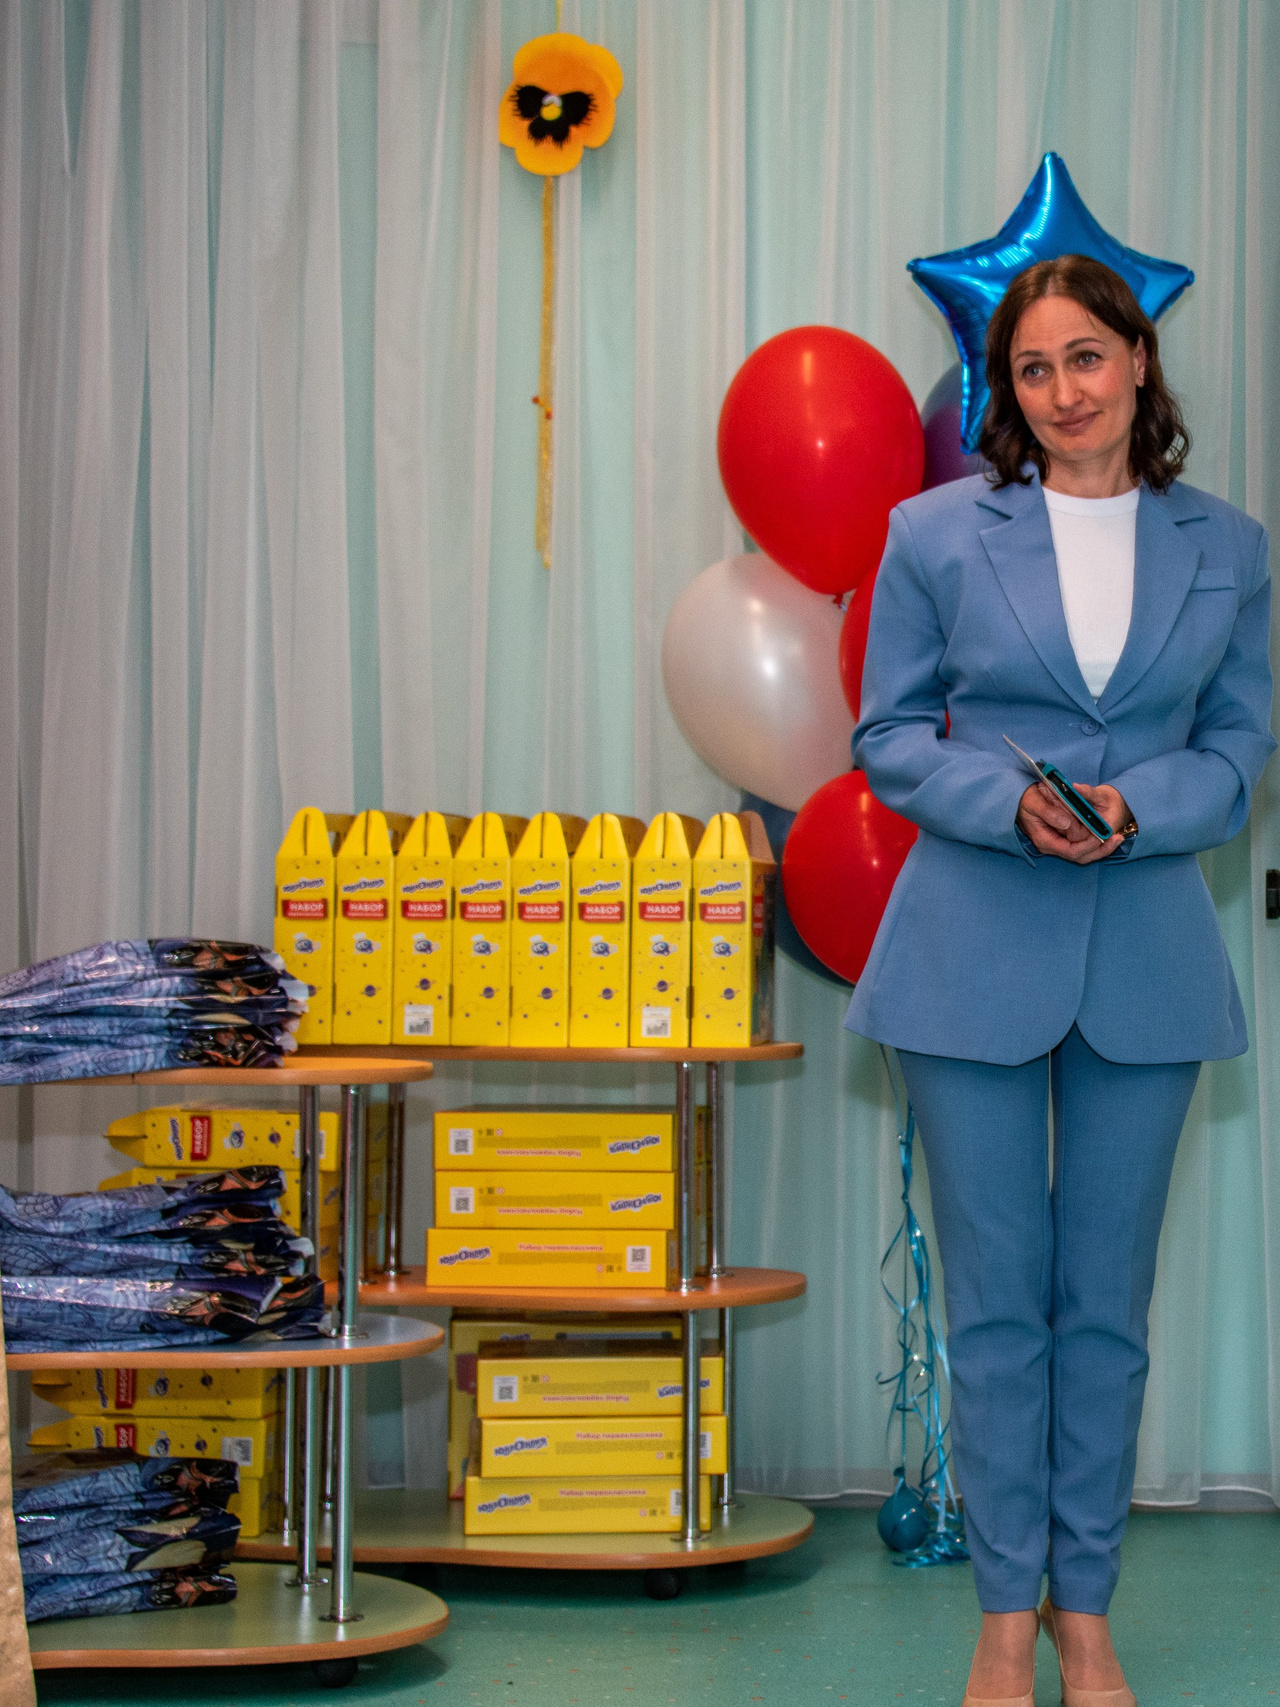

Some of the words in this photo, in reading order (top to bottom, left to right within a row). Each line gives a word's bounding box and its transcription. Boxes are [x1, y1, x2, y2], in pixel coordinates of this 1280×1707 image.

[289, 904, 324, 912] НАБОР
[350, 904, 384, 912] НАБОР
[409, 904, 443, 912] НАБОР
[467, 905, 501, 914] НАБОР
[525, 905, 560, 915] НАБОР
[586, 905, 620, 915] НАБОР
[646, 905, 681, 914] НАБОР
[707, 905, 741, 915] НАБОР
